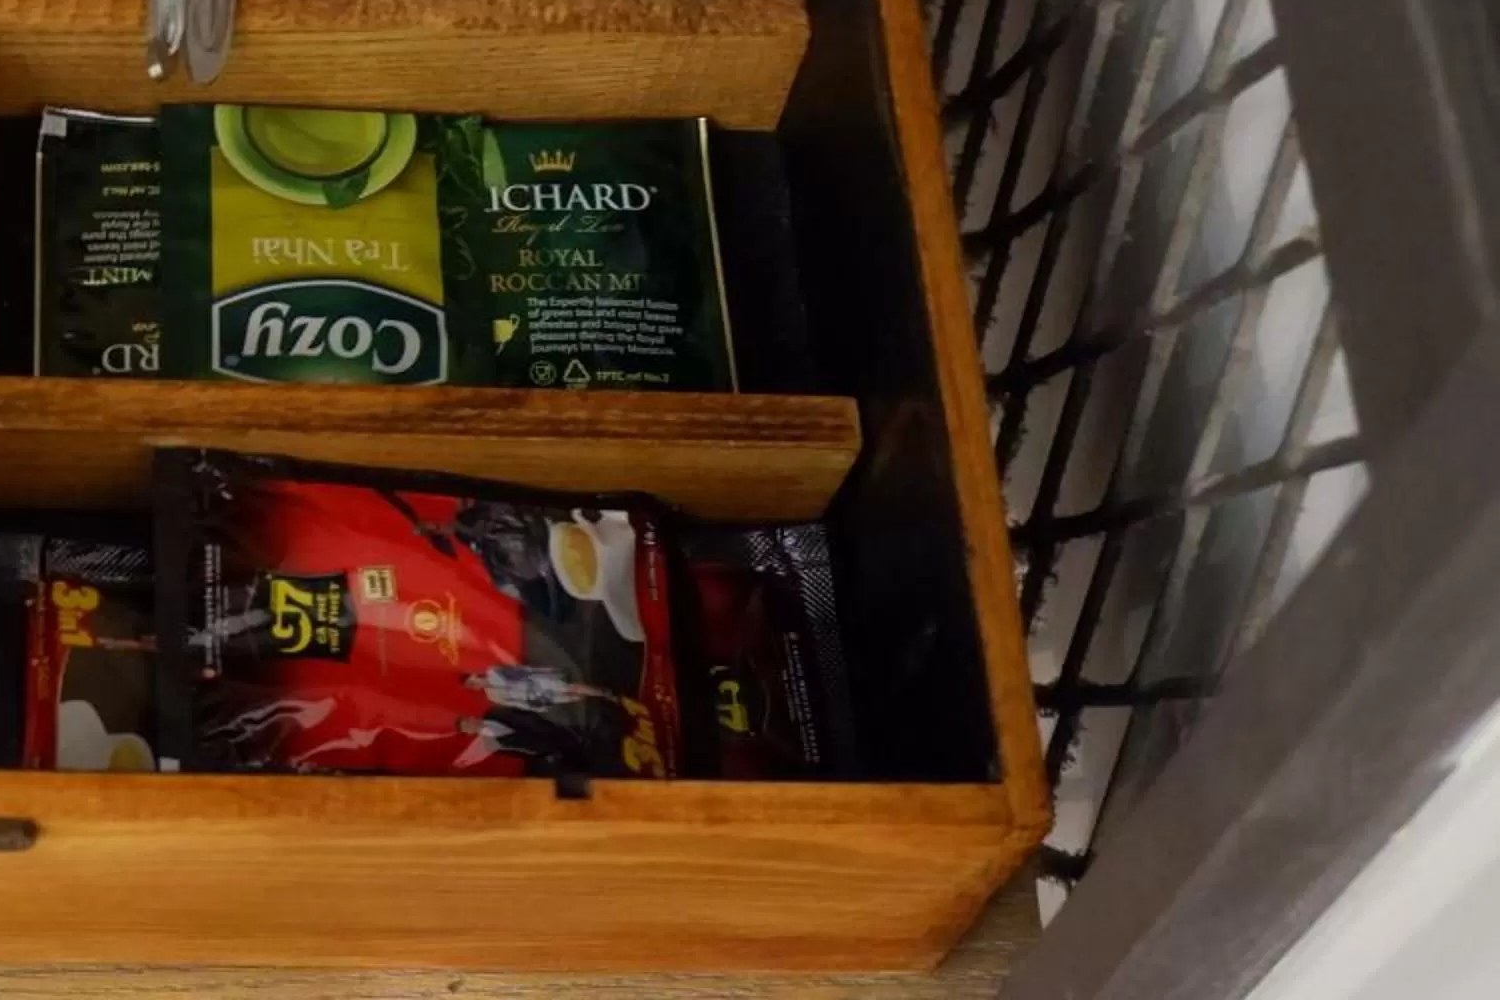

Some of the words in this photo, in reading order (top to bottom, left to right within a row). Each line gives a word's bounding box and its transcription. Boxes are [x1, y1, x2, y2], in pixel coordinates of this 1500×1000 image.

[484, 183, 650, 212] ICHARD
[253, 237, 337, 265] Nhài
[345, 239, 408, 272] Trà
[519, 248, 604, 267] ROYAL
[241, 301, 421, 375] Cozy
[268, 579, 315, 655] G7
